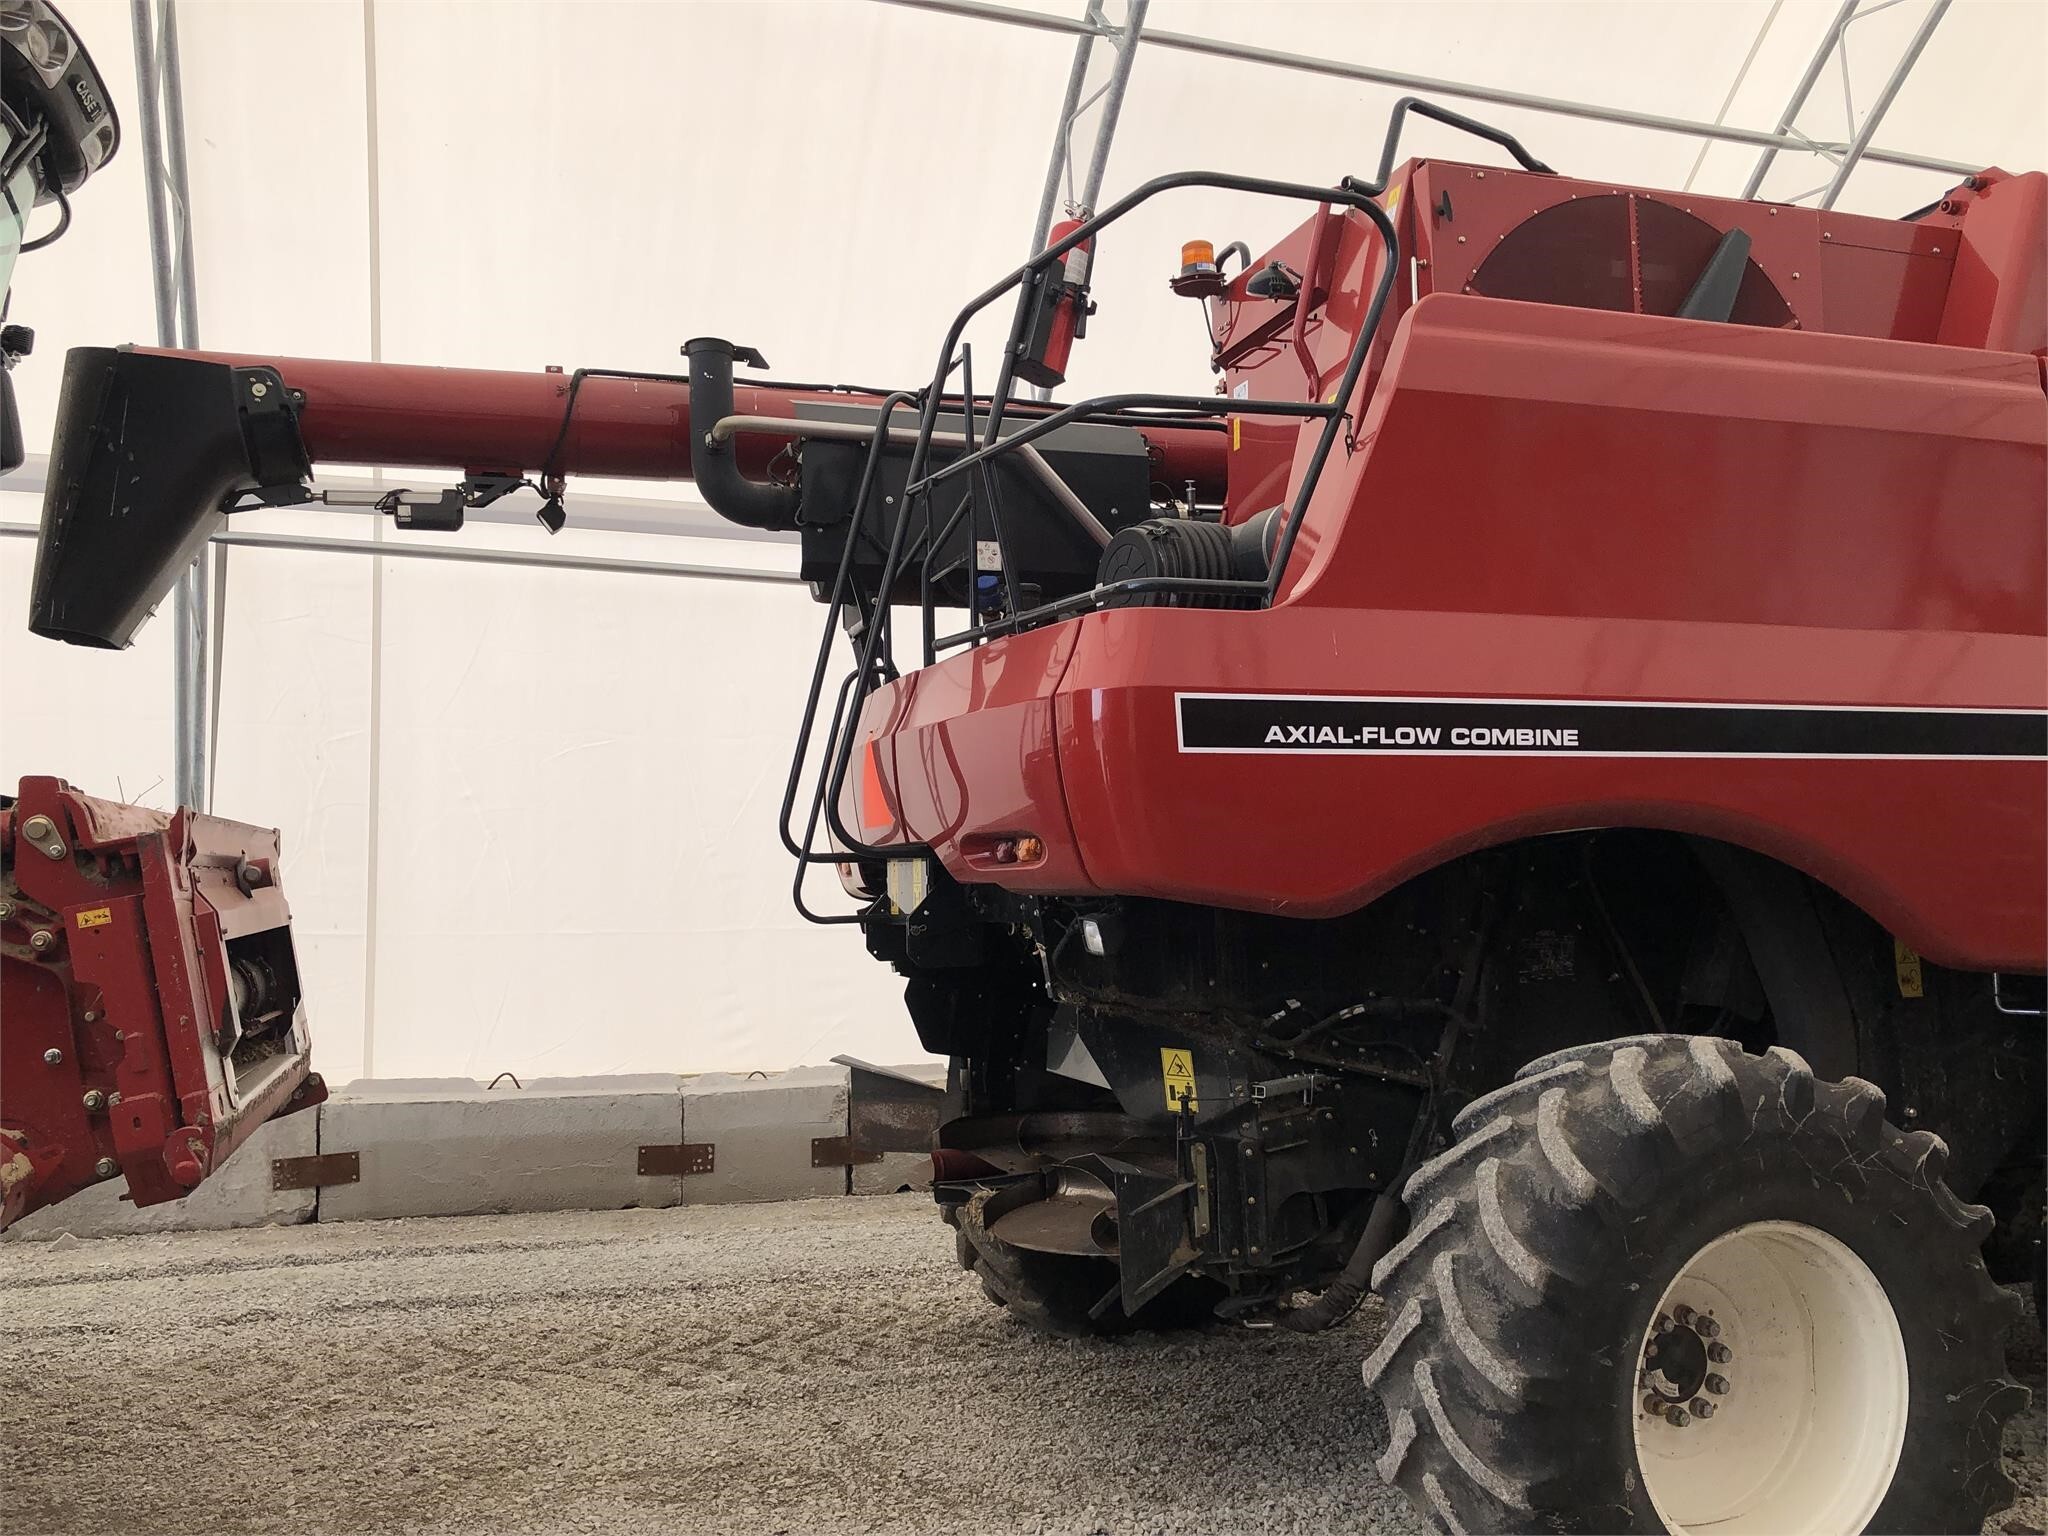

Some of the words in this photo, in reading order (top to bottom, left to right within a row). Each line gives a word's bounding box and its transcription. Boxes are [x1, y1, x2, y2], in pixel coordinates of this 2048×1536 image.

[76, 80, 97, 113] CASE
[1264, 725, 1441, 745] AXIAL-FLOW
[1450, 727, 1579, 746] COMBINE
